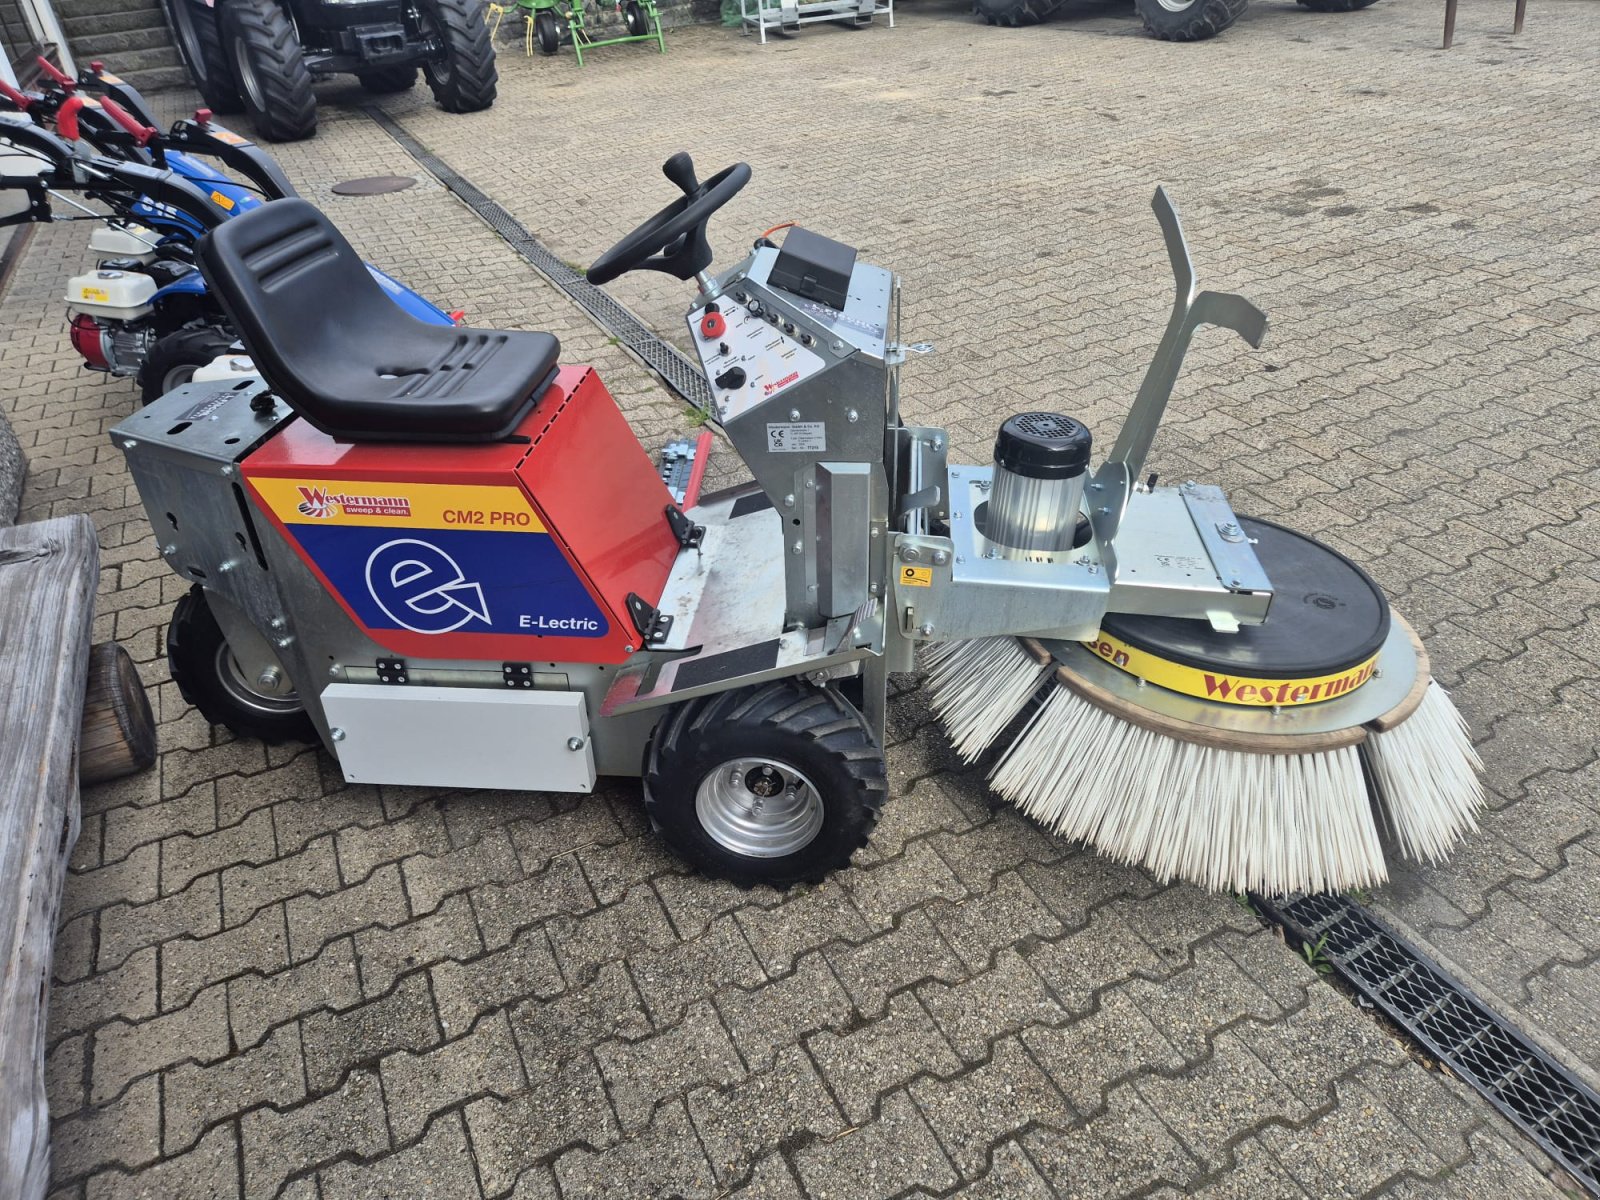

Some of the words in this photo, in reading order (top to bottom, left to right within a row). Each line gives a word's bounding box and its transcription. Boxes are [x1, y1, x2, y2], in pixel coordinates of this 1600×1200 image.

[297, 486, 410, 507] Westermann
[346, 507, 373, 515] sweep
[384, 507, 409, 515] clean.
[443, 510, 484, 525] CM2
[490, 511, 531, 526] PRO
[519, 615, 598, 630] E-Lectric
